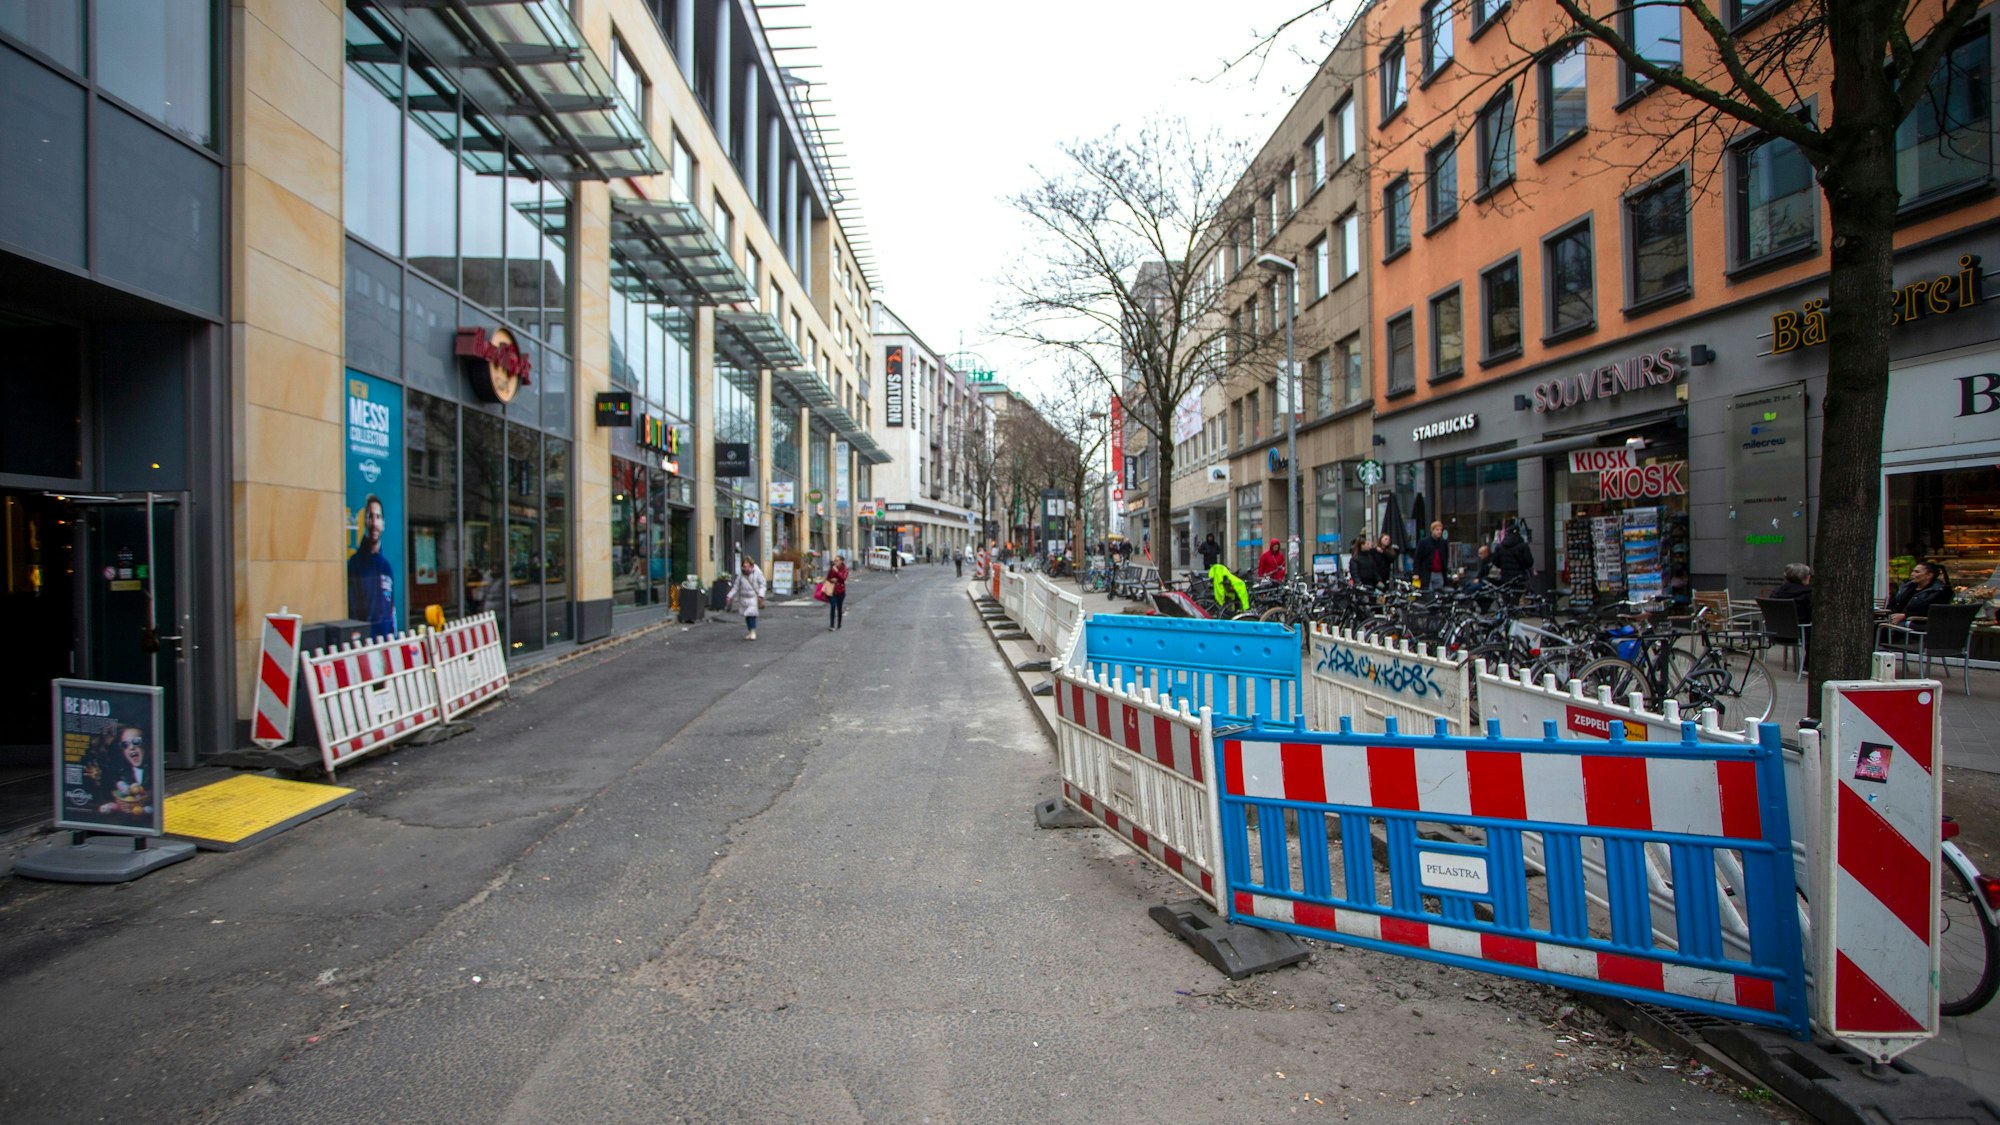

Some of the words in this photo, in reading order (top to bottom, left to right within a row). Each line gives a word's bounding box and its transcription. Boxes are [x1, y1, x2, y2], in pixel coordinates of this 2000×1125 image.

[1772, 255, 1974, 354] Bärei
[1534, 348, 1675, 414] SOUVENIRS
[887, 374, 902, 423] SATURN
[349, 396, 389, 433] MESSI
[350, 425, 389, 447] COLLECTION
[1412, 413, 1475, 442] STARBUCKS
[1742, 438, 1786, 449] milecrew
[1575, 449, 1630, 471] KIOSK
[1600, 461, 1685, 500] KIOSK
[64, 696, 79, 713] BE
[80, 698, 111, 717] BOLD
[1574, 713, 1609, 732] ZEPPELI
[1426, 864, 1480, 880] PFLASTRA
